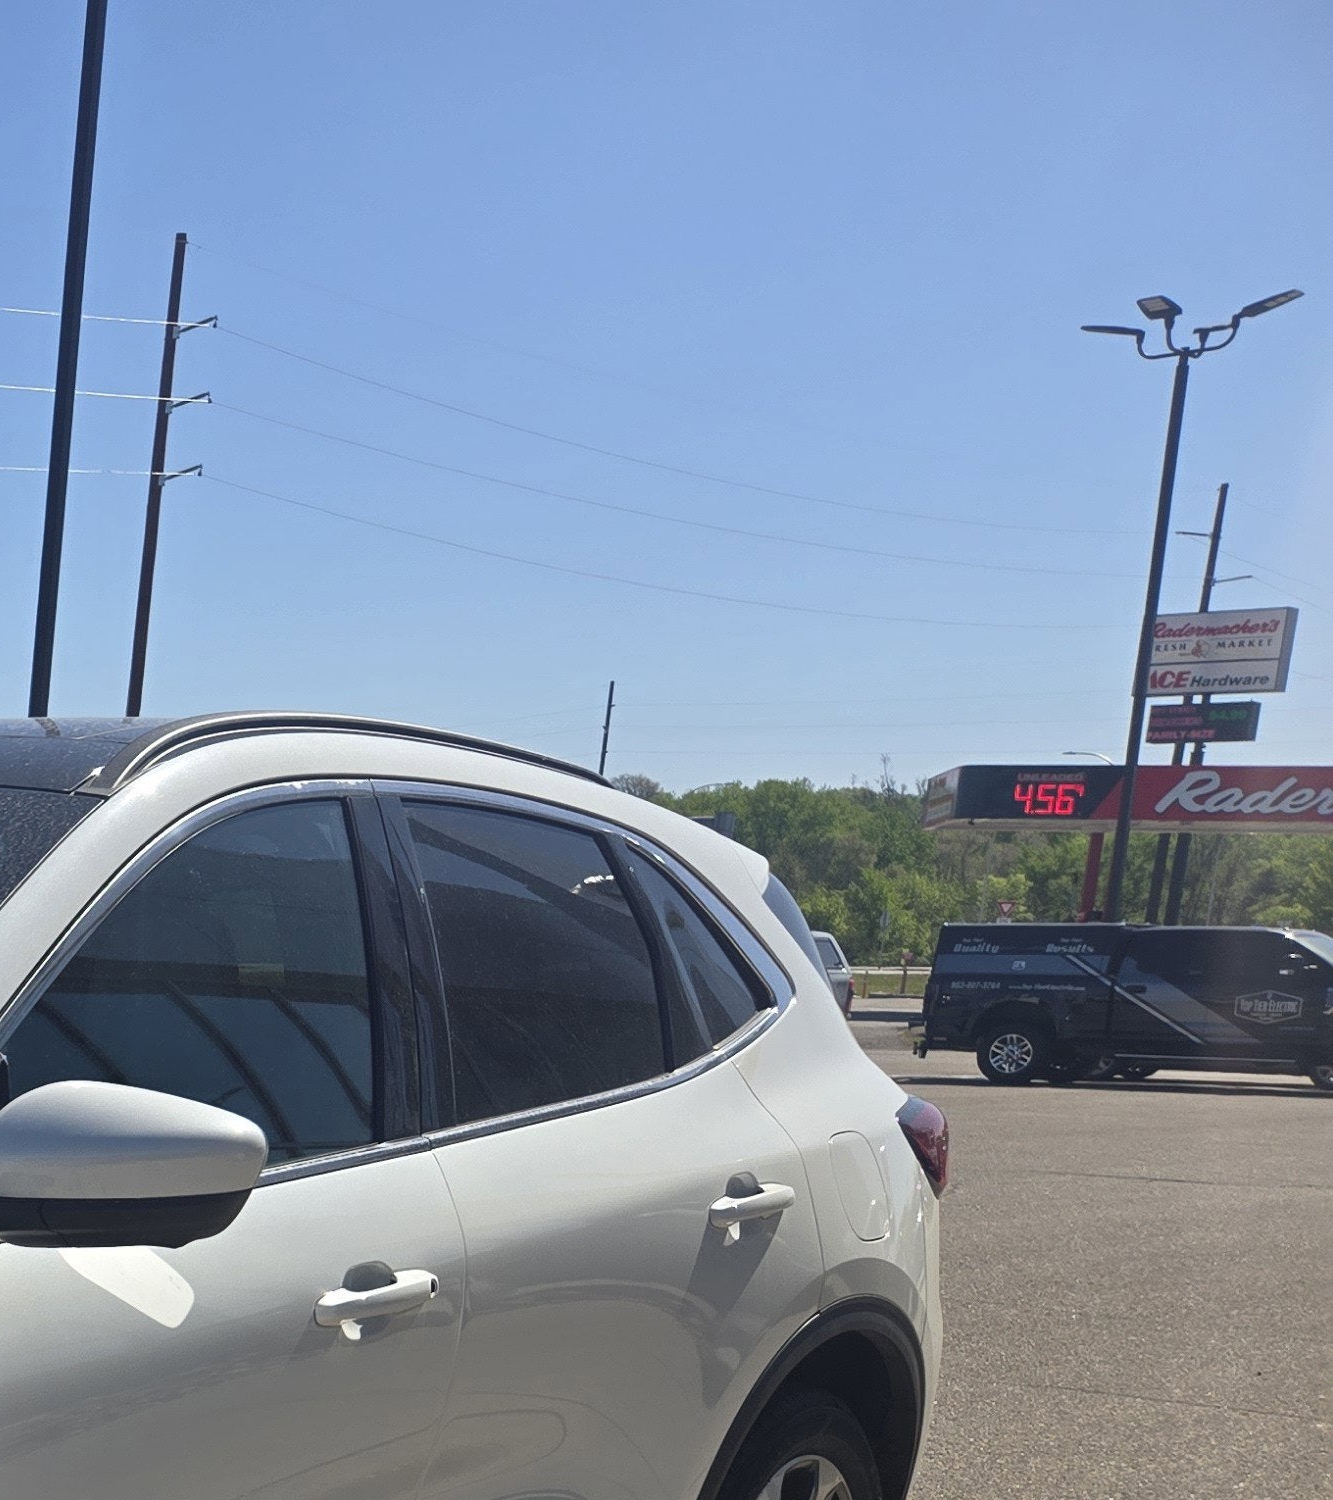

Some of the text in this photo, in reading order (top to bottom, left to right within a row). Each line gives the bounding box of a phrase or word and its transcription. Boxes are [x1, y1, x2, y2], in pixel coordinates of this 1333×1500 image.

[1153, 638, 1273, 653] RESH MARKET
[1190, 674, 1269, 688] Hardware
